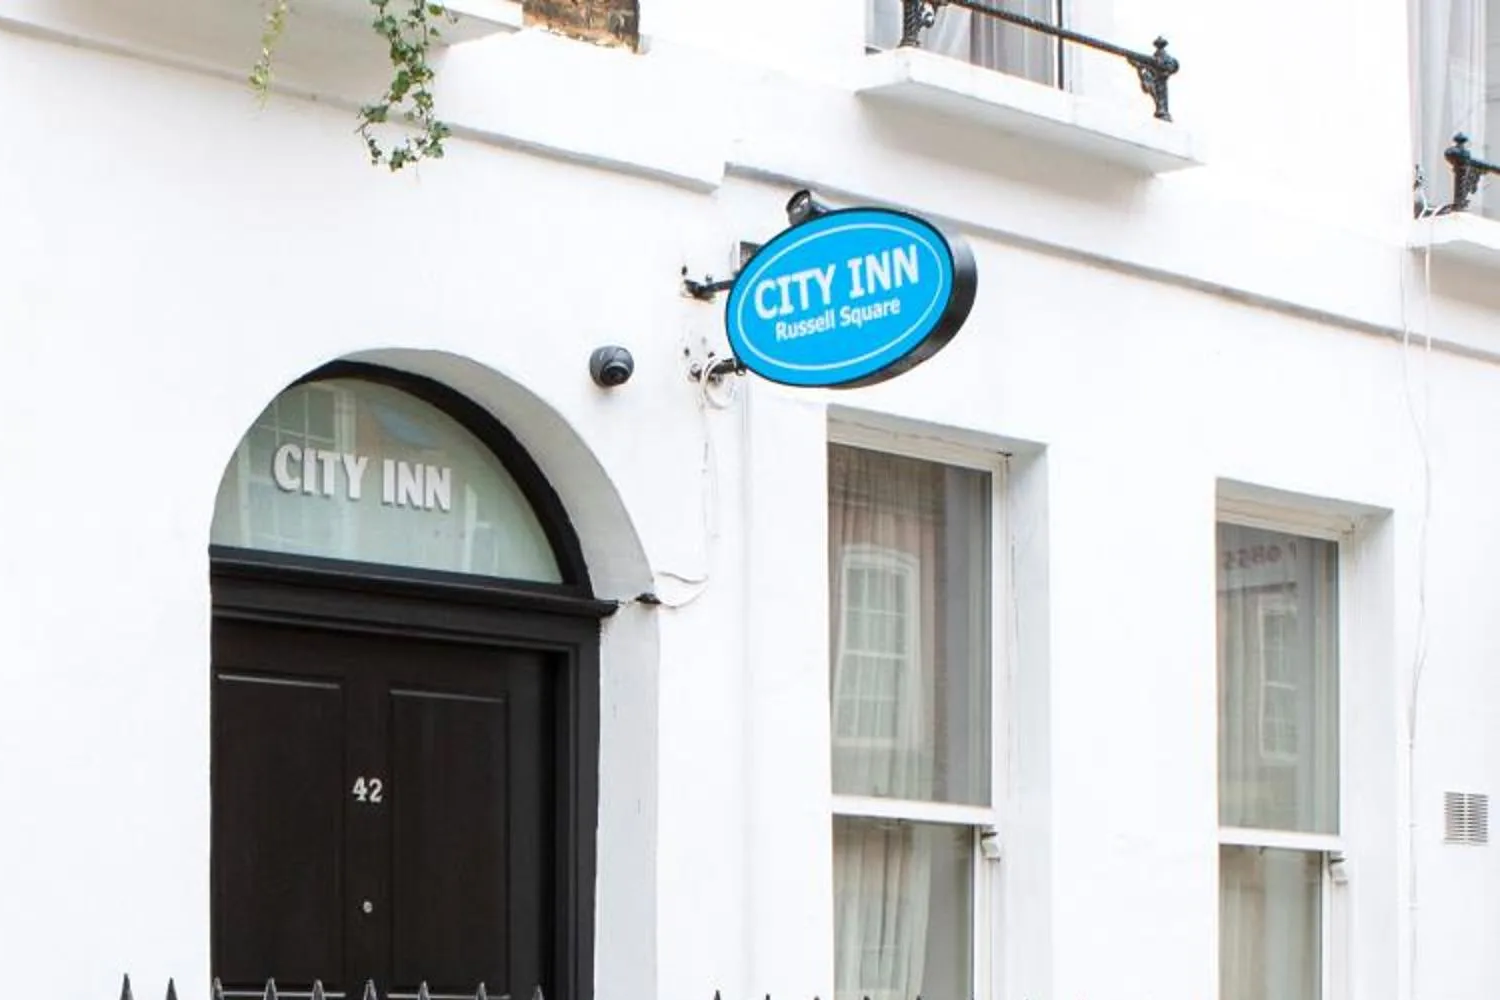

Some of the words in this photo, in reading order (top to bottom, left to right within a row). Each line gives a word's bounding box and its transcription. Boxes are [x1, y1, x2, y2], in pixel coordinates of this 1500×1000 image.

[755, 264, 836, 319] CITY
[847, 244, 920, 298] INN
[775, 314, 836, 342] Russell
[840, 299, 901, 329] Square
[273, 444, 368, 500] CITY
[382, 458, 451, 512] INN
[352, 776, 383, 803] 42
